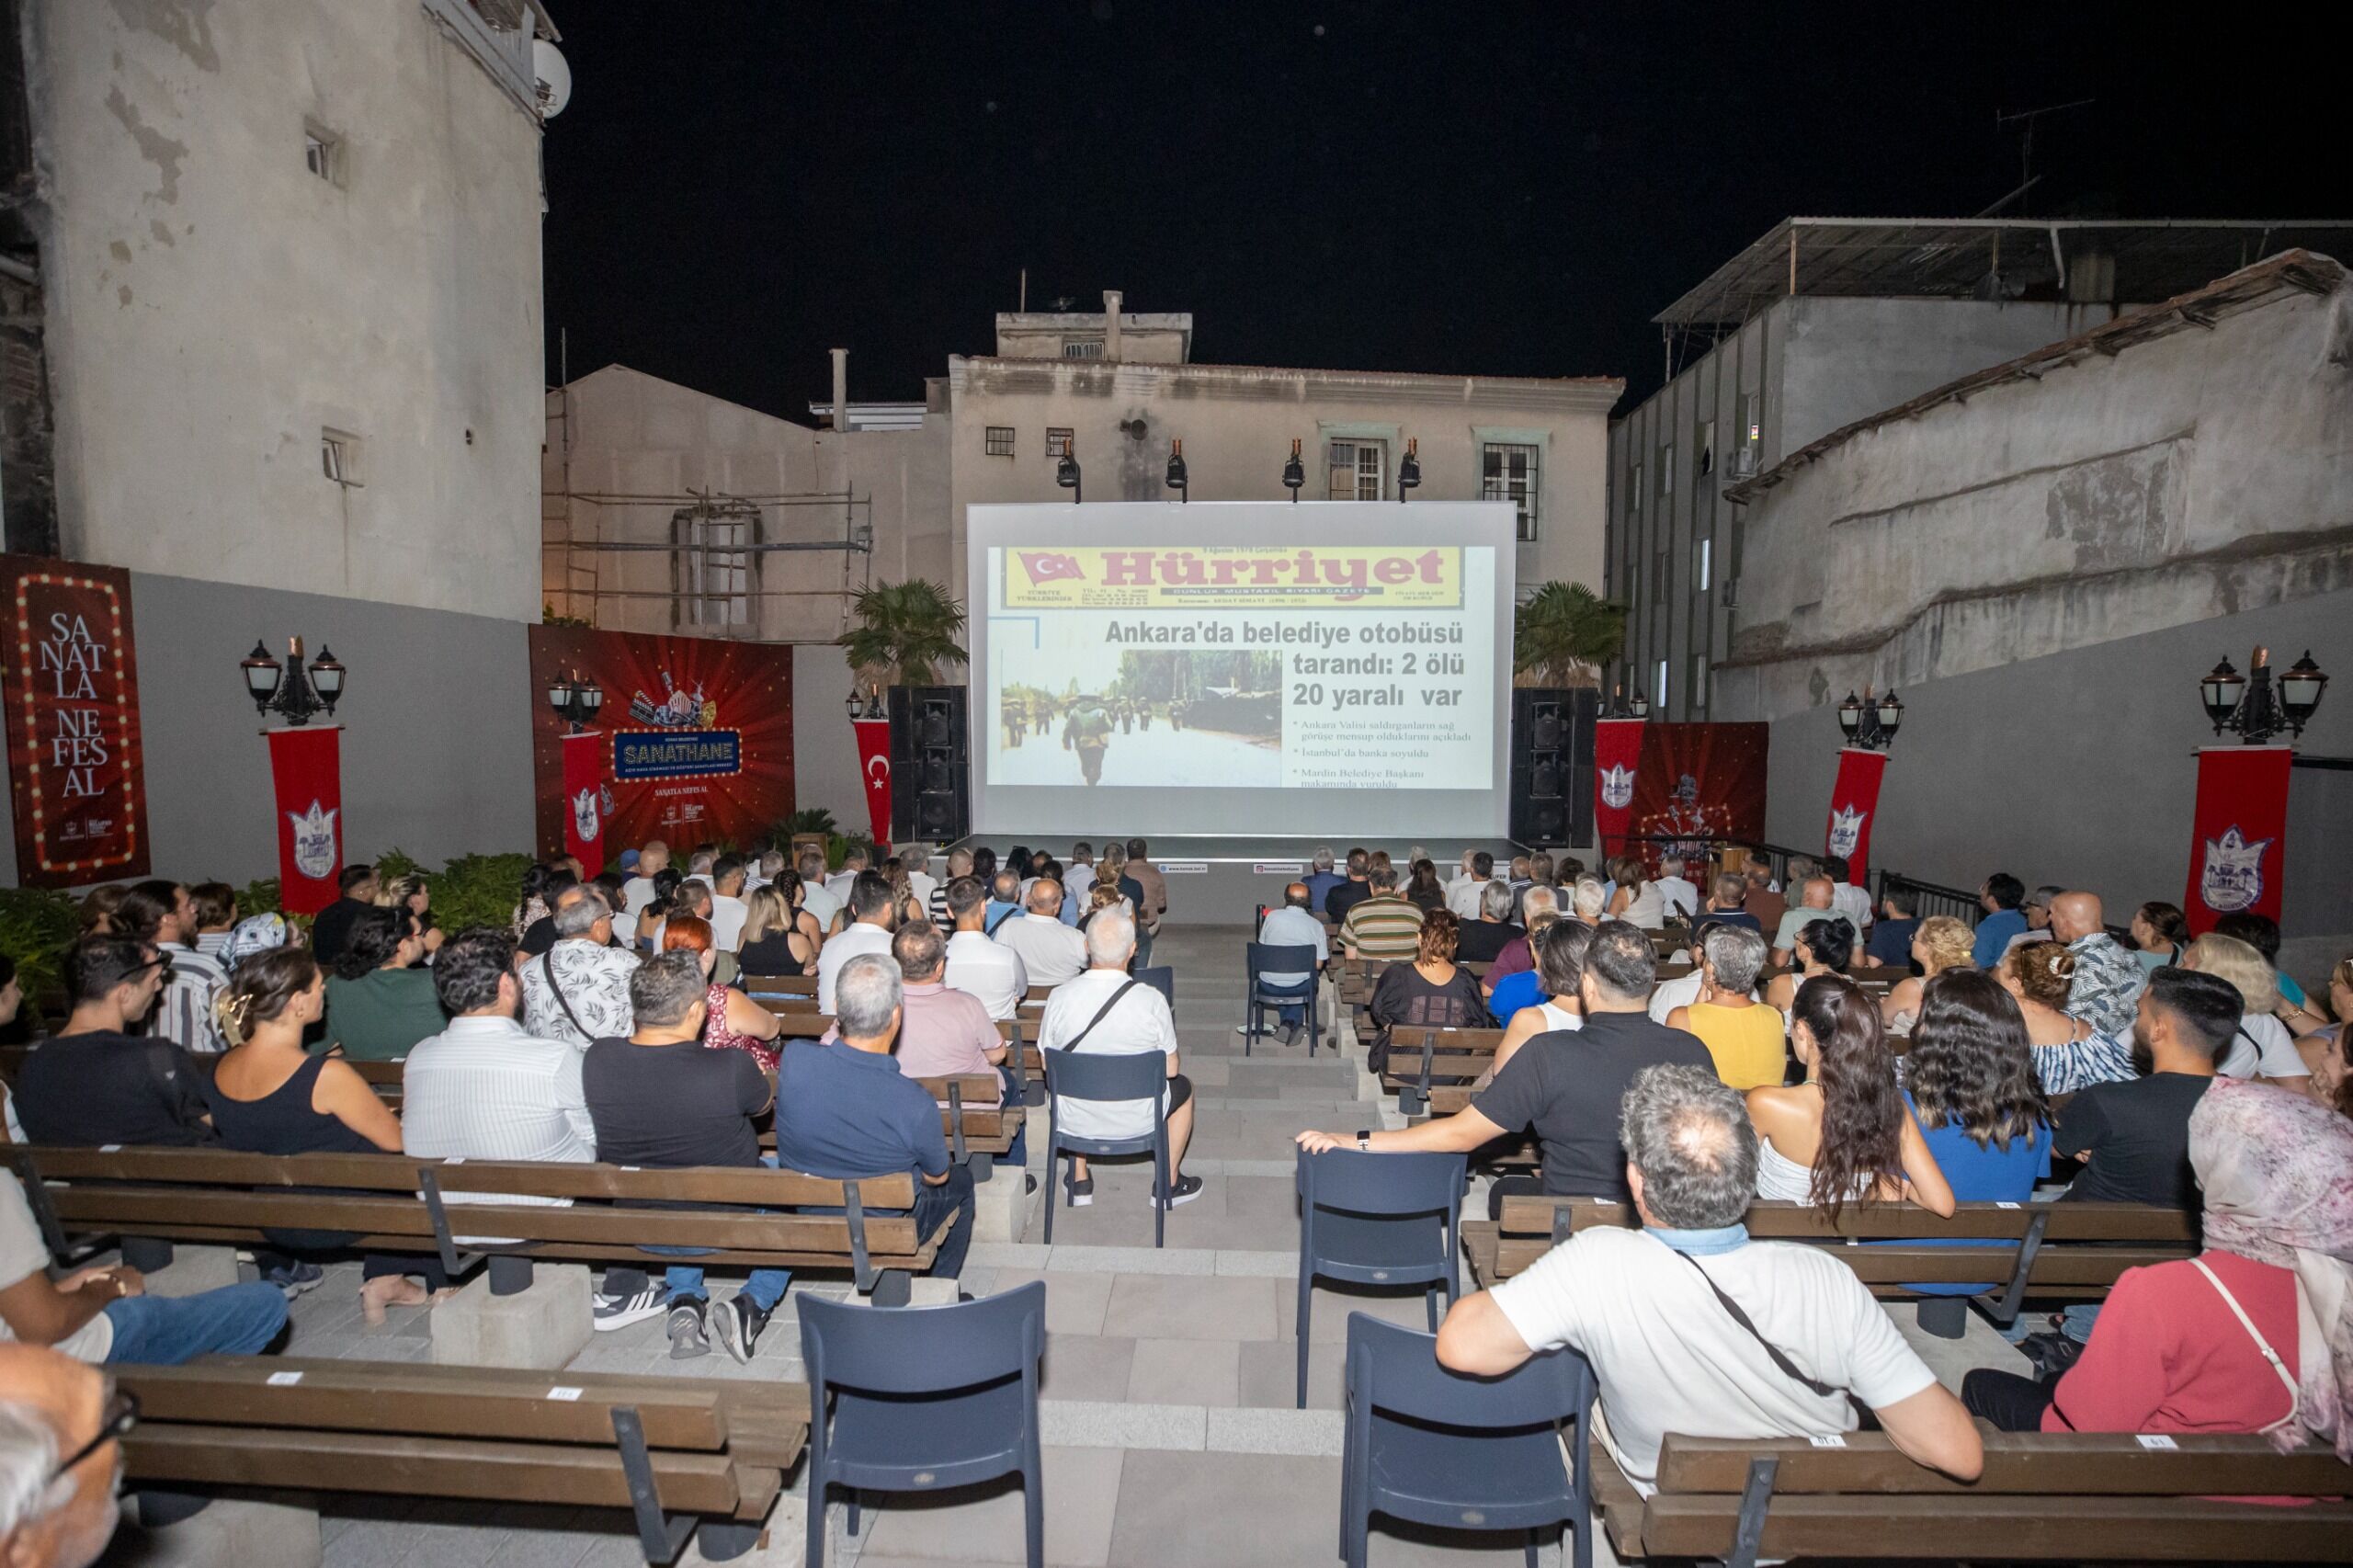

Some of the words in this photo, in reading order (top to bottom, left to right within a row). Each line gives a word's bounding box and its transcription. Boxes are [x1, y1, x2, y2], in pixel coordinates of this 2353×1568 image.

[1100, 550, 1444, 601] Hürriyet
[51, 612, 93, 643] SA
[1106, 621, 1233, 642] Ankara'da
[1243, 621, 1350, 649] belediye
[1359, 621, 1463, 643] otobüsü
[40, 641, 107, 672] NAT
[1293, 653, 1392, 675] tarandı:
[1402, 653, 1416, 674] 2
[1426, 652, 1464, 675] ölü
[55, 669, 98, 699] LA
[1293, 684, 1324, 706] 20
[1333, 685, 1404, 710] yaralı
[1421, 688, 1461, 706] var
[56, 710, 102, 737] NE
[1339, 721, 1366, 729] Valisi
[1369, 722, 1436, 732] saldırganların
[1438, 722, 1455, 732] sağ
[1302, 733, 1334, 742] görüşe
[1377, 733, 1430, 742] olduklarını
[51, 737, 108, 767] FES
[623, 742, 733, 765] SANATHANE
[1358, 749, 1388, 757] banka
[1390, 749, 1429, 759] soyuldu
[63, 768, 106, 798] AL
[1301, 769, 1336, 778] Mardin
[1339, 769, 1382, 779] Belediye
[1385, 769, 1424, 779] Başkanı
[654, 787, 682, 797] SANATLA
[682, 786, 700, 795] NEFES
